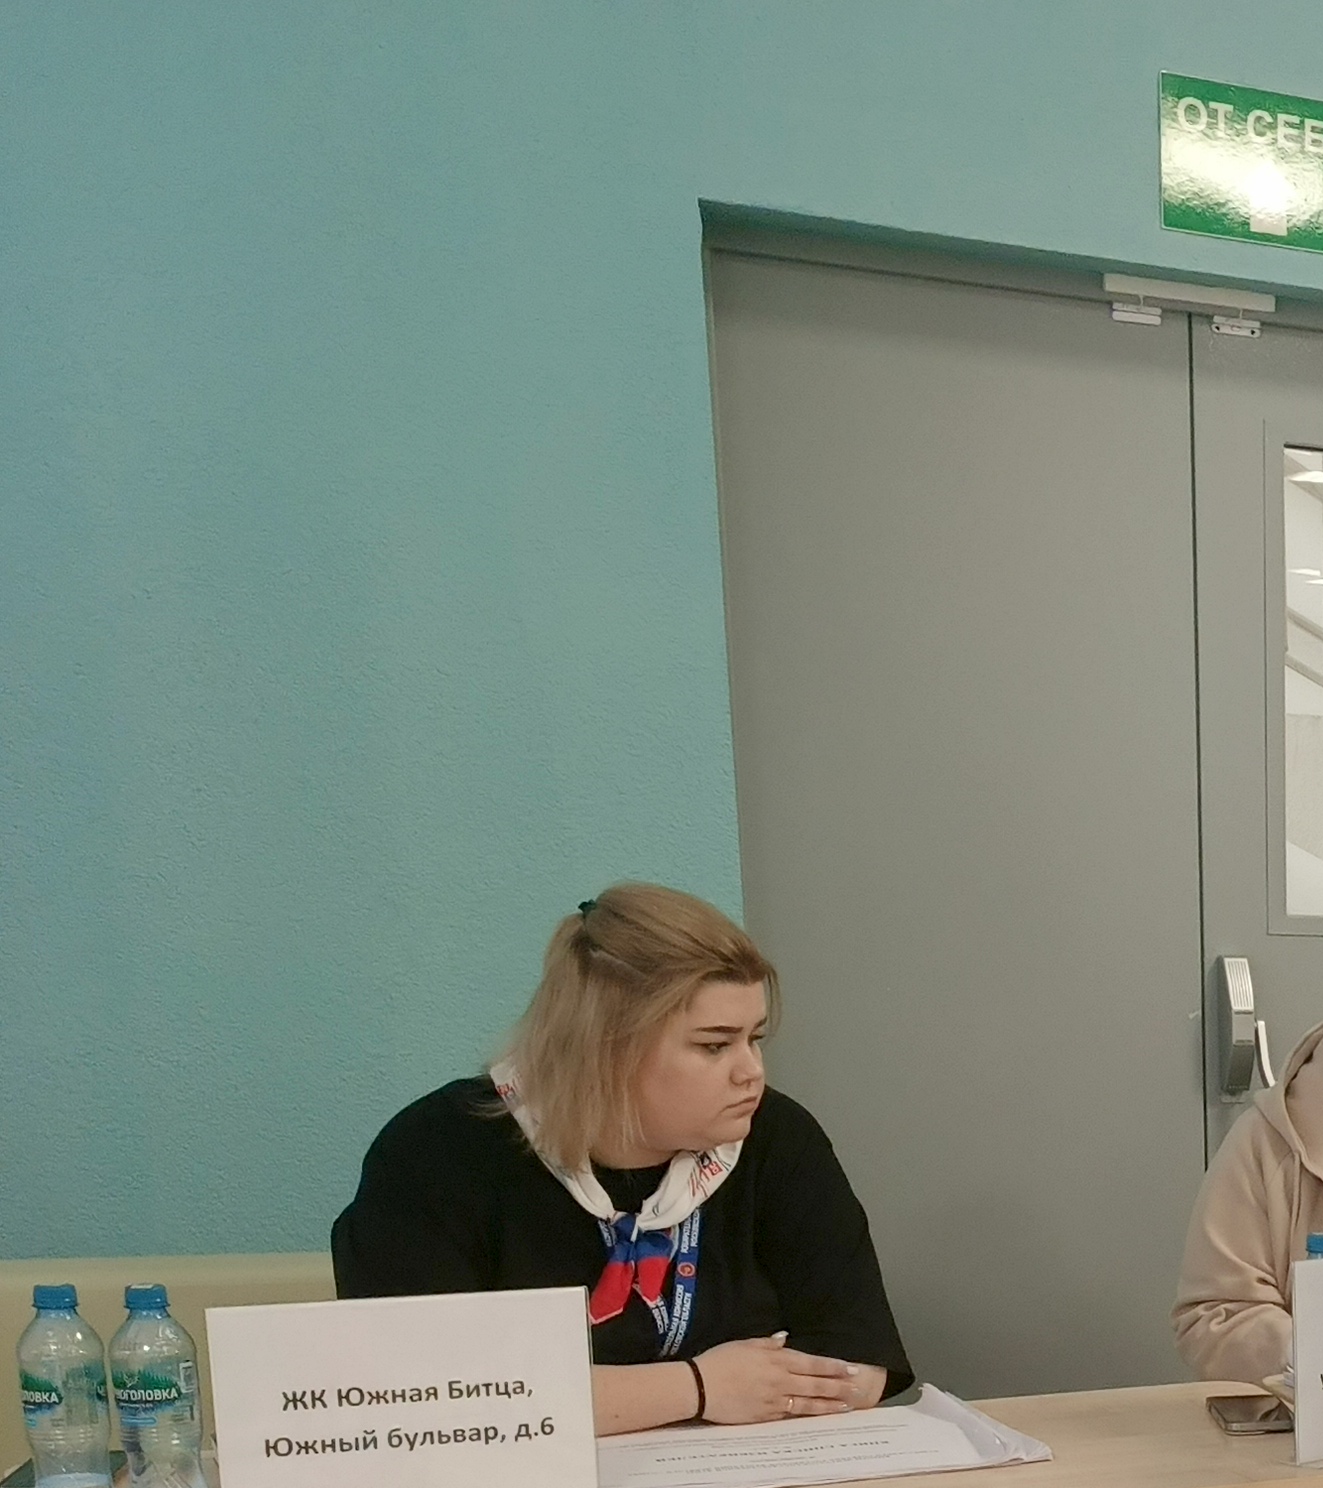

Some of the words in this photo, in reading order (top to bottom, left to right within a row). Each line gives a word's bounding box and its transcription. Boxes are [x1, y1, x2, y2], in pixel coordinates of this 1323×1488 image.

[1177, 96, 1234, 137] ОТ
[282, 1388, 328, 1412] ЖК
[337, 1386, 438, 1407] Южная
[448, 1379, 533, 1400] Битца,
[264, 1429, 379, 1458] Южный
[387, 1425, 506, 1451] бульвар,
[514, 1416, 555, 1442] д.6
